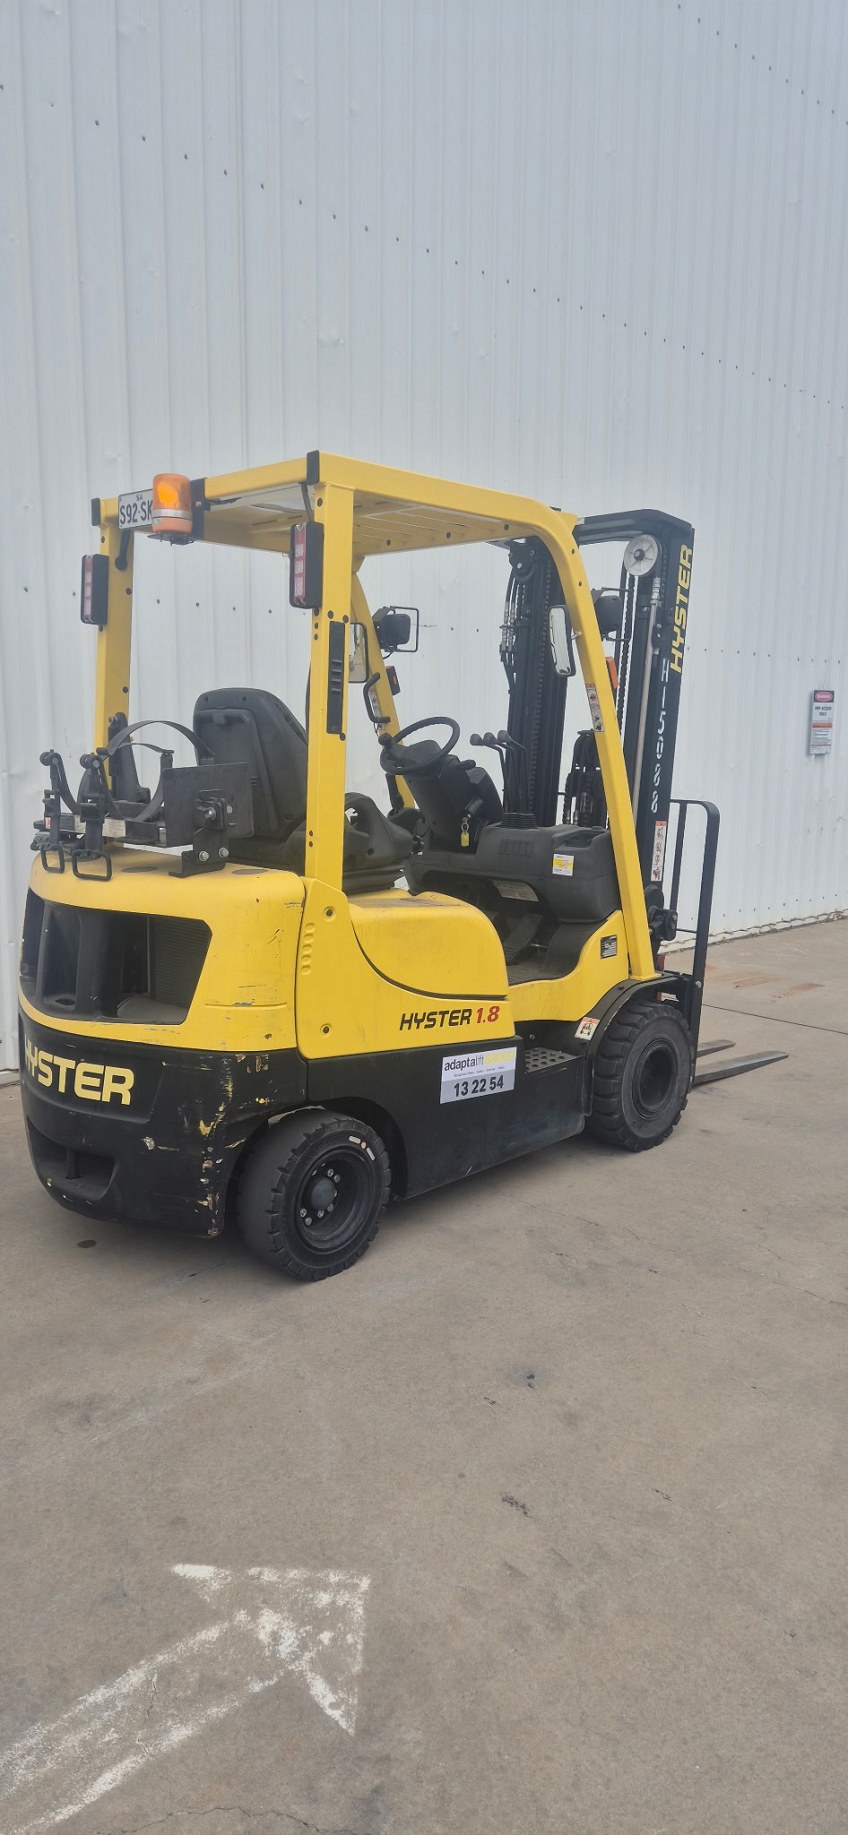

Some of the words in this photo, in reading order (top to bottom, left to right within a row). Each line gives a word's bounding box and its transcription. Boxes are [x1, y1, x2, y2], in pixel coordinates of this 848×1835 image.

[670, 544, 693, 673] HYSTER
[399, 1008, 472, 1031] HYSTER
[476, 1005, 500, 1024] 1.8
[25, 1034, 135, 1106] HYSTER
[453, 1082, 469, 1098] 13
[471, 1078, 487, 1095] 22
[489, 1075, 504, 1091] 54
